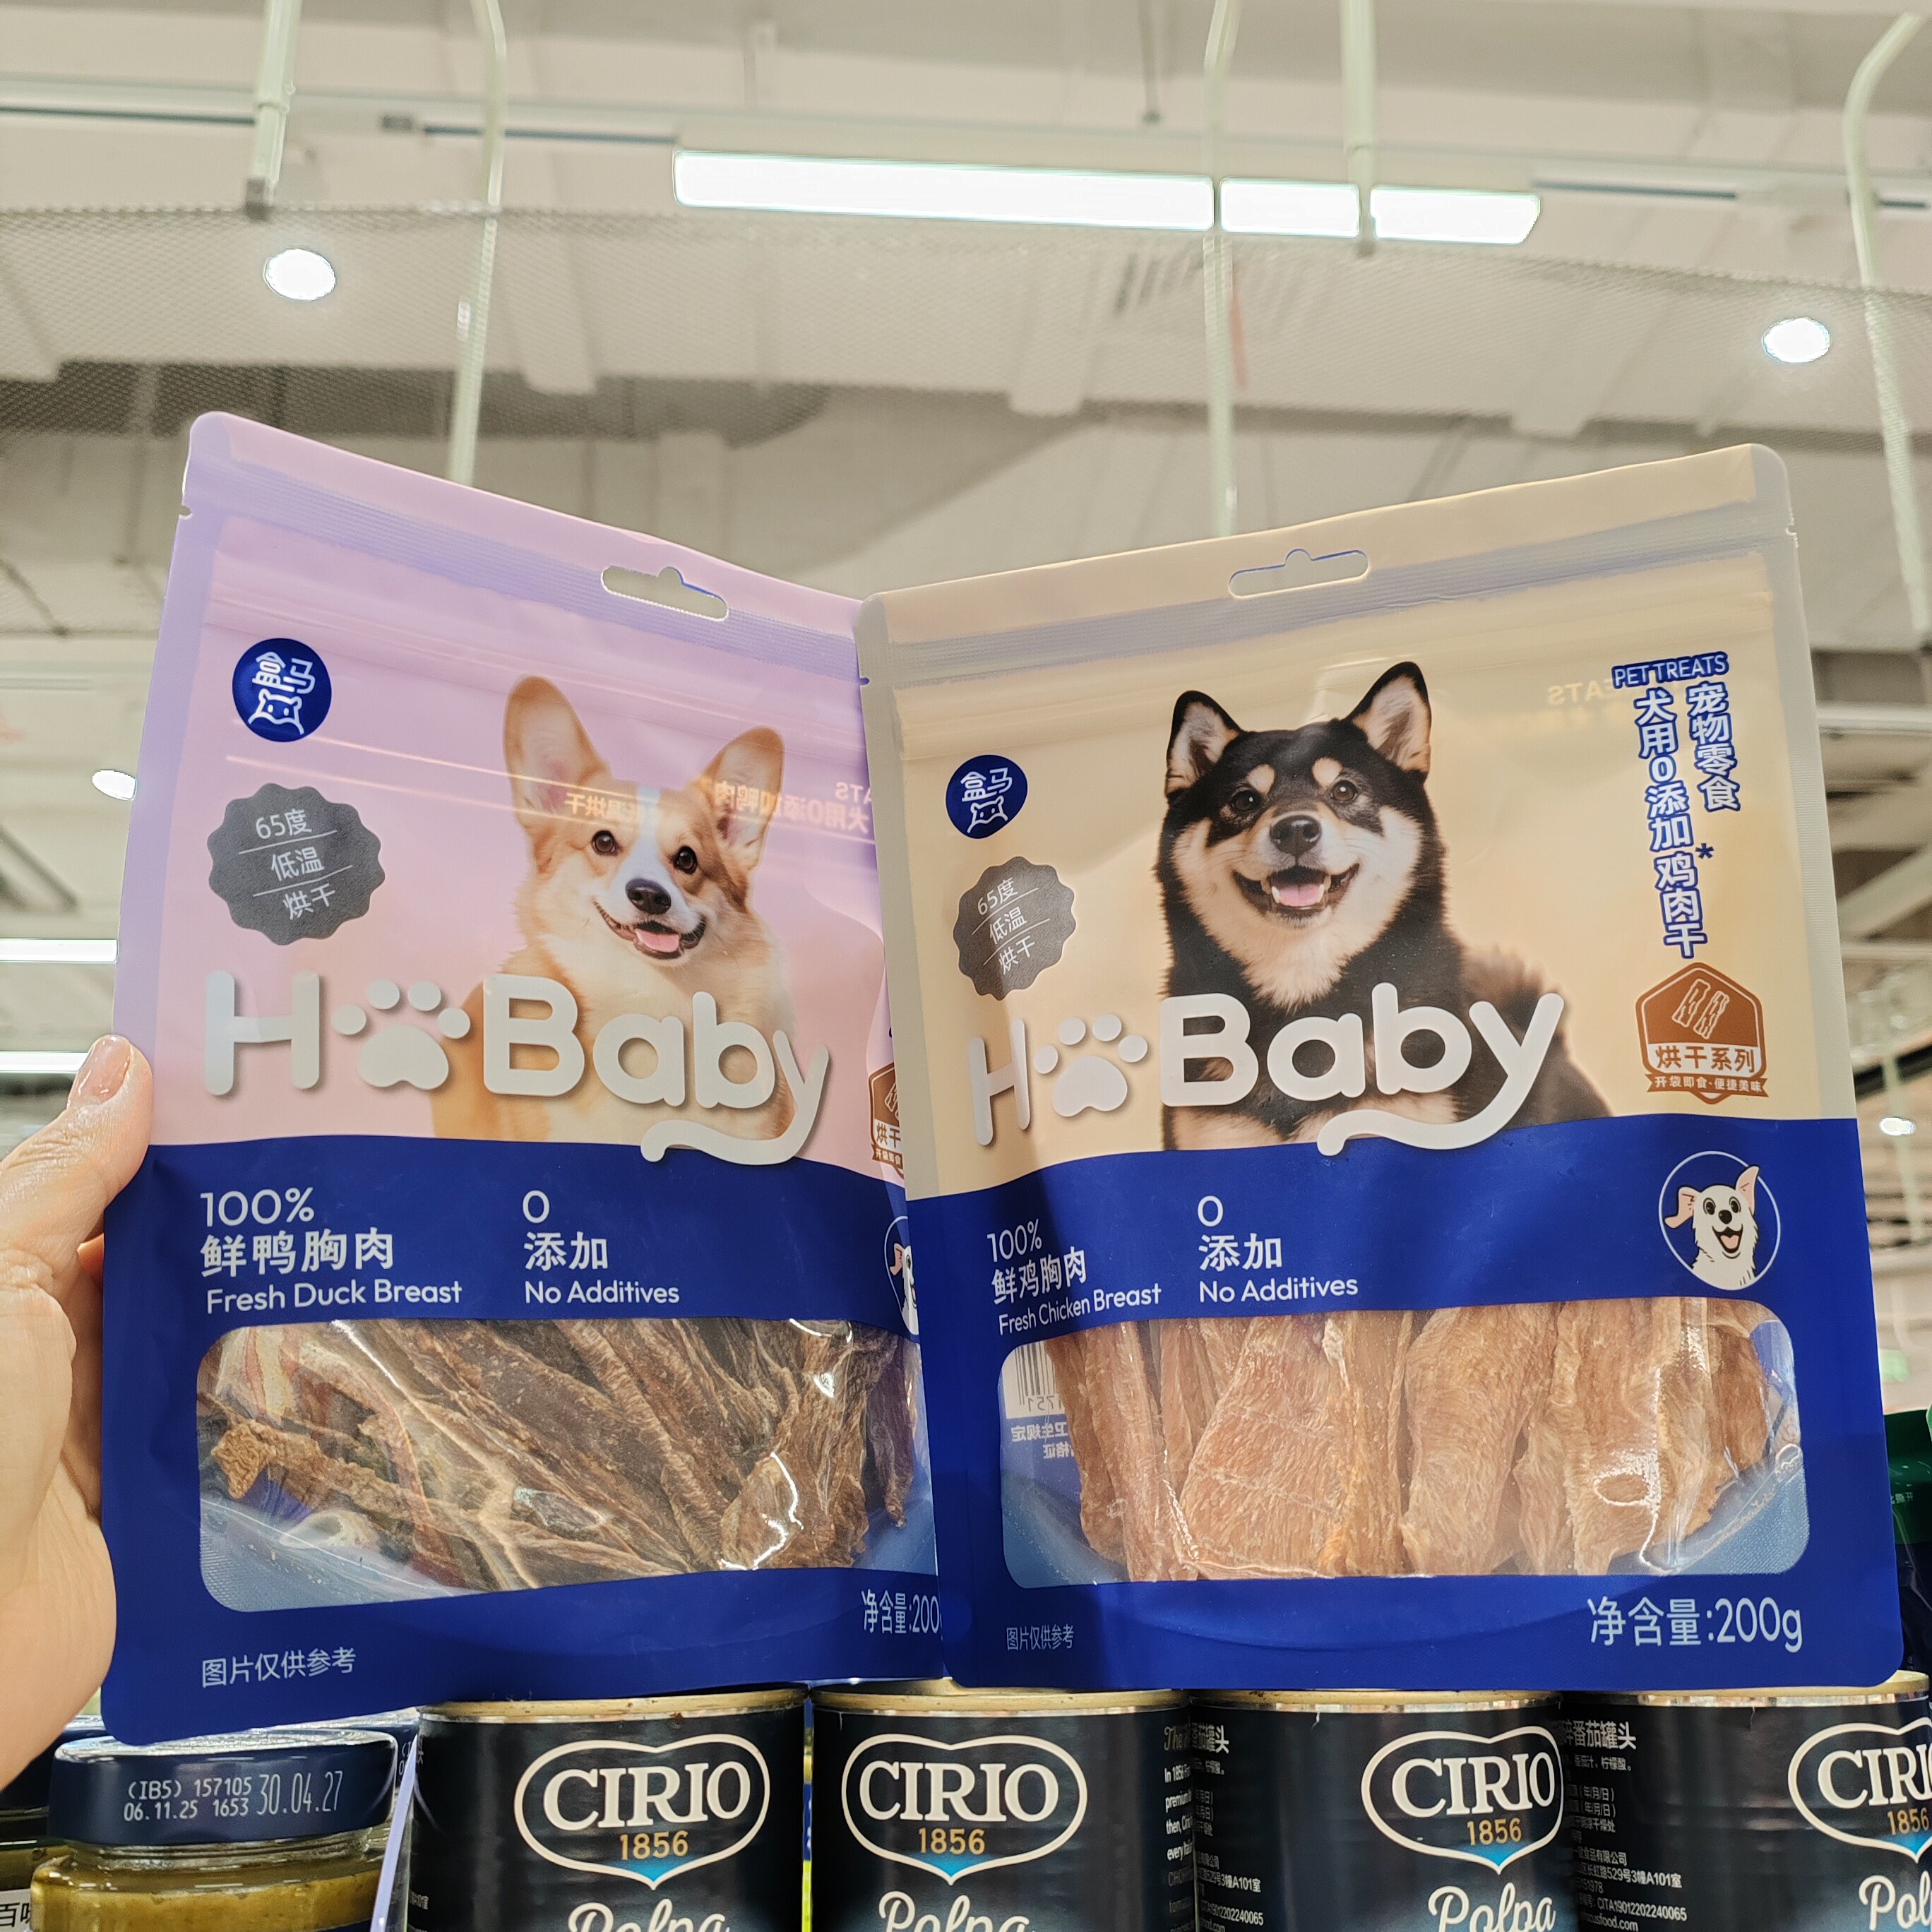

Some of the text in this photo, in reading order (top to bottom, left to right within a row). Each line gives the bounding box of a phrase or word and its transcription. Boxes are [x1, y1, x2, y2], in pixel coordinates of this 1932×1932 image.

[251, 650, 316, 695] 盒马
[1614, 654, 1727, 687] PET TREATS
[1688, 683, 1740, 811] 宠物零食
[960, 767, 1013, 802] 盒马
[255, 808, 313, 840] 65度
[270, 847, 324, 882] 低温
[282, 883, 336, 919] 烘干
[977, 876, 1018, 915] 65度
[989, 907, 1027, 945] 低温
[999, 936, 1035, 974] 烘干
[482, 974, 830, 1166] Baby
[1160, 982, 1565, 1157] Baby
[1654, 1045, 1755, 1073] 烘干系列
[200, 1187, 315, 1227] 100%
[200, 1227, 393, 1278] 鲜鸭胸肉
[523, 1231, 609, 1272] 添加
[986, 1218, 1042, 1263] 100%
[1198, 1232, 1283, 1272] 添加
[525, 1279, 680, 1304] No Additives
[991, 1246, 1087, 1305] 鲜鸡胸肉
[1200, 1277, 1359, 1303] No Additives
[207, 1278, 463, 1314] Fresh Duck Breast
[998, 1282, 1162, 1336] Fresh Chicken Breast
[861, 1588, 942, 1634] 净含量:200
[1587, 1595, 1803, 1653] 净含量:200g
[1006, 1623, 1075, 1651] 图片仅供参考
[201, 1646, 357, 1688] 图片仅供参考
[128, 1776, 253, 1800] (IB5) 157105
[256, 1770, 344, 1815] 30.04.27
[542, 1760, 751, 1831] CIRIO
[859, 1760, 1059, 1823] CIRIO
[1391, 1751, 1555, 1818] CIRIO
[1818, 1743, 1932, 1809] CIRI
[123, 1797, 250, 1822] 06.11.25 1653
[1887, 1807, 1930, 1835] 1856
[619, 1830, 689, 1861] 1856
[918, 1827, 986, 1854] 1856
[1466, 1817, 1522, 1846] 1856
[1428, 1882, 1557, 1932] Polpa
[1859, 1870, 1932, 1931] Pol
